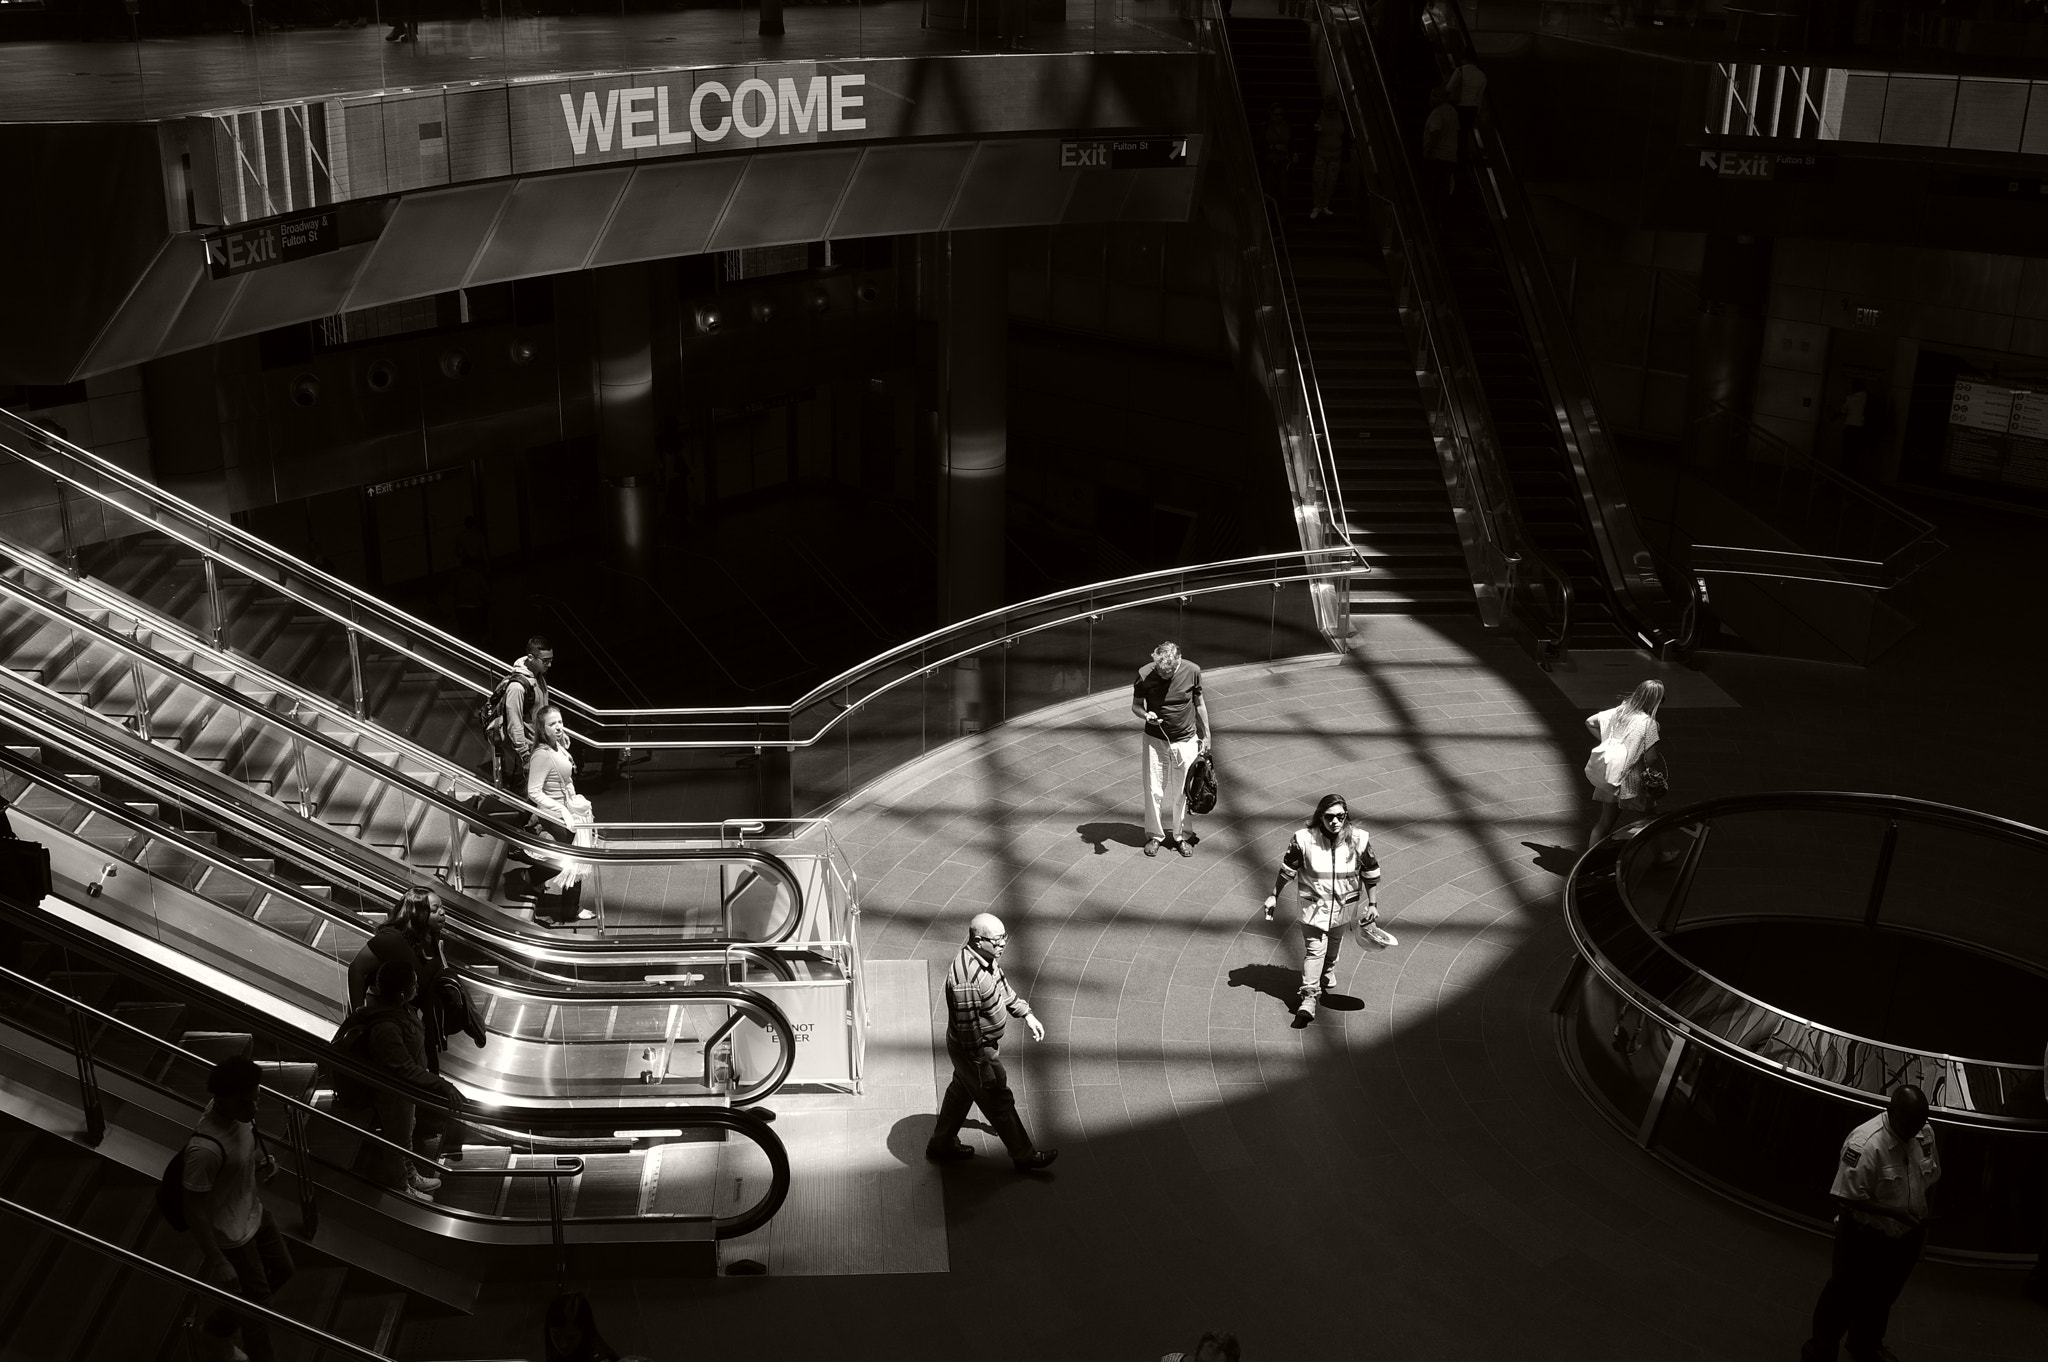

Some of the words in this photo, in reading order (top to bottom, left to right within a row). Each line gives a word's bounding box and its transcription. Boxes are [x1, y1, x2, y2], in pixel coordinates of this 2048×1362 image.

[560, 73, 867, 155] WELCOME
[1061, 143, 1107, 166] Exit
[1113, 142, 1138, 151] Fulton
[1139, 141, 1149, 150] St
[1719, 152, 1768, 176] Exit
[280, 219, 320, 236] Broadway
[226, 229, 277, 270] Exit
[281, 233, 307, 248] Fulton
[307, 230, 318, 242] St
[375, 482, 393, 495] Exit
[771, 1033, 810, 1043] EER
